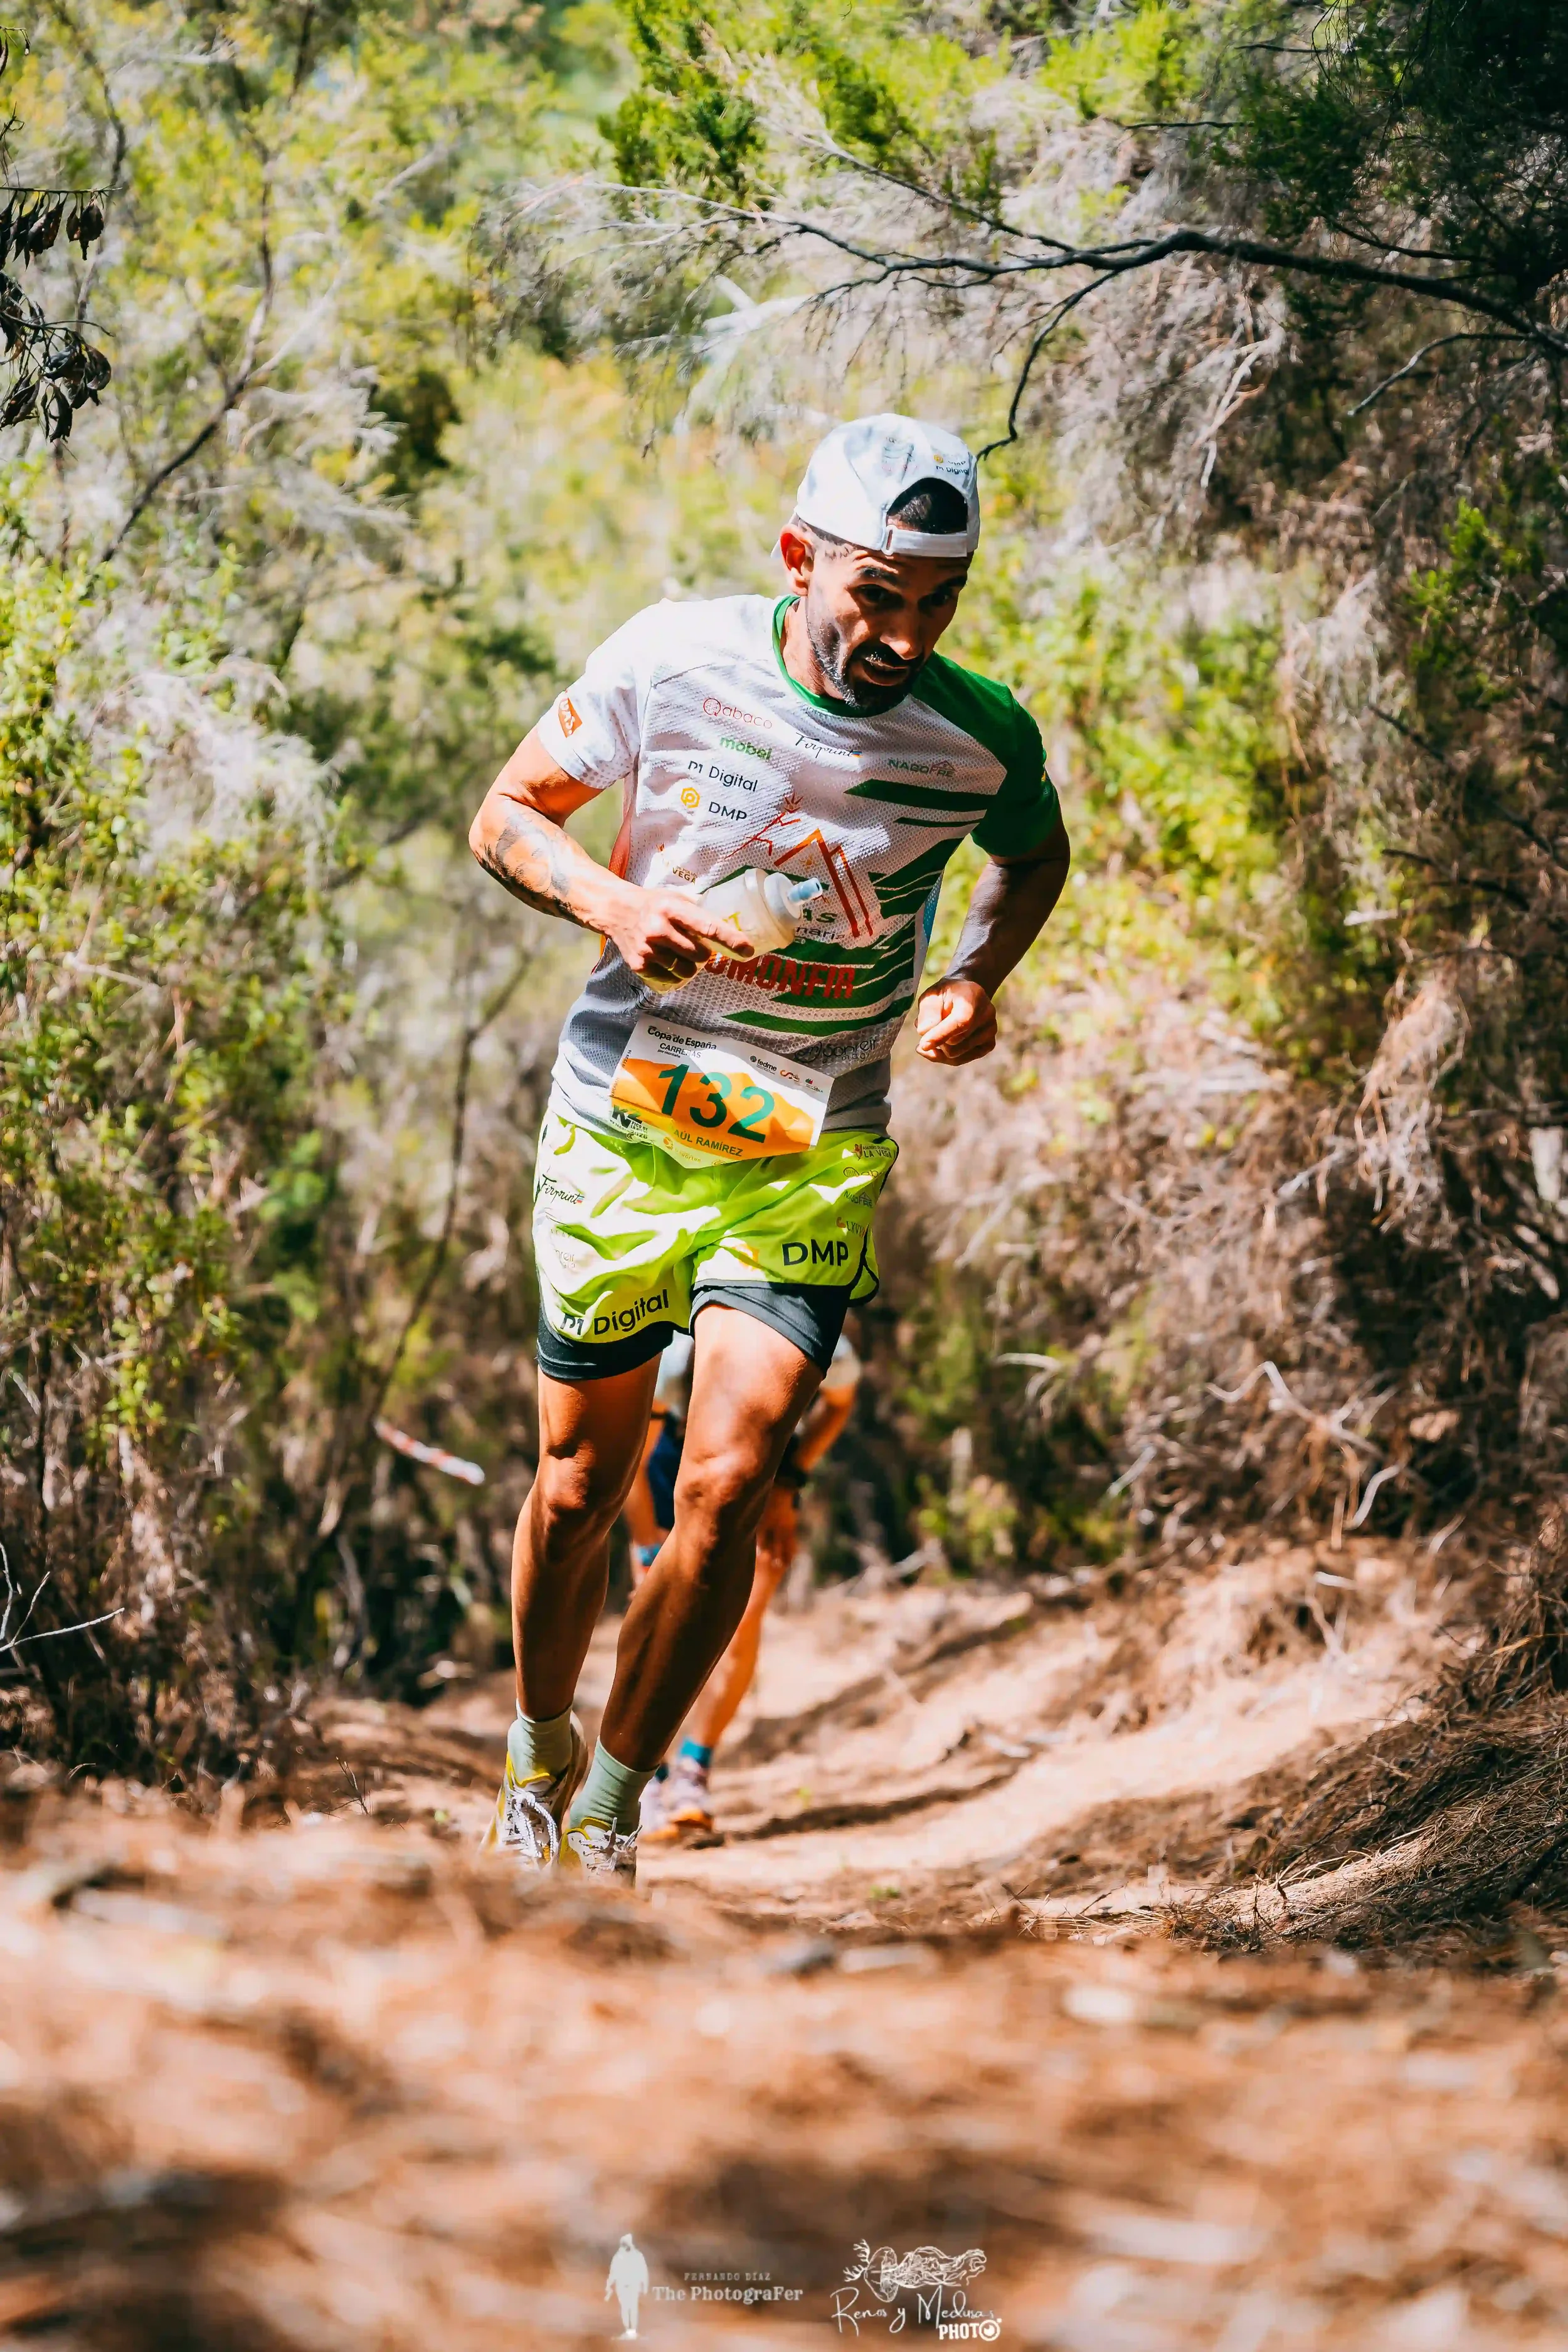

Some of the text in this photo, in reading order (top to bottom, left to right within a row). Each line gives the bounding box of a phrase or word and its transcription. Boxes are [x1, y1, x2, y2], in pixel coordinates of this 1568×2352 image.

[709, 765, 758, 792] Digital
[709, 801, 748, 821] DMP
[672, 867, 696, 884] VEGA
[647, 1025, 717, 1050] Copa de España
[659, 1042, 701, 1058] CARREAS
[757, 1059, 777, 1072] fedme
[659, 1064, 775, 1143] 132
[674, 1129, 744, 1157] AÚL RAMÍREZ
[863, 1150, 875, 1158] LA
[782, 1239, 849, 1267] DMP
[593, 1289, 669, 1335] Digital
